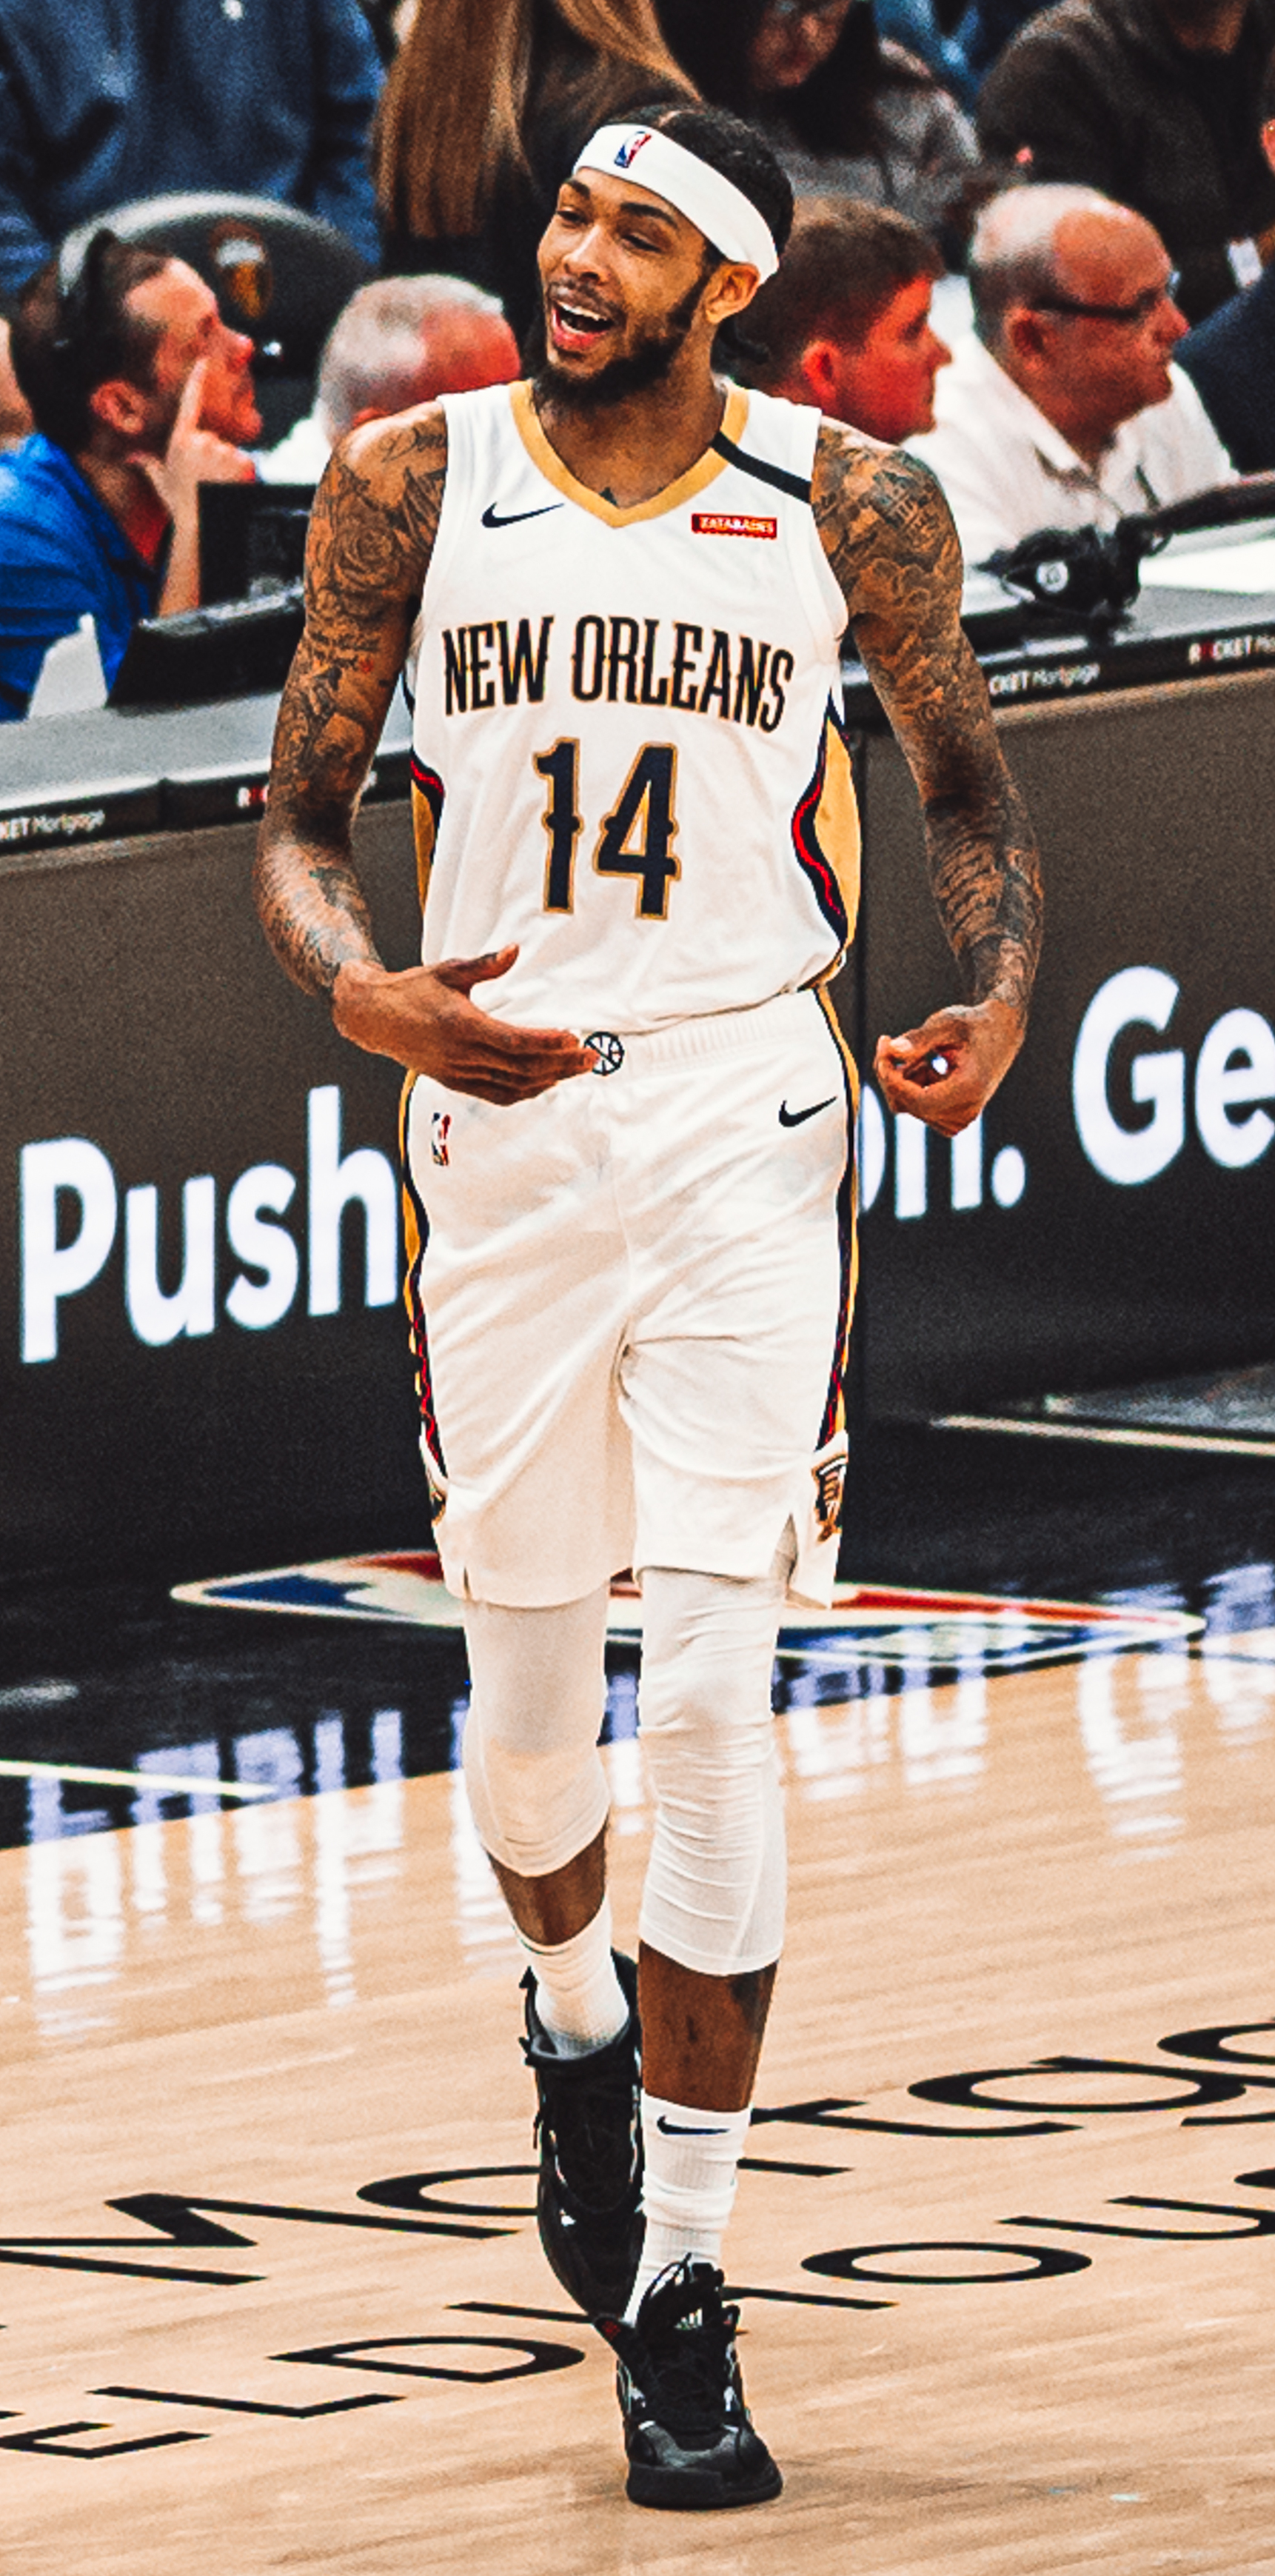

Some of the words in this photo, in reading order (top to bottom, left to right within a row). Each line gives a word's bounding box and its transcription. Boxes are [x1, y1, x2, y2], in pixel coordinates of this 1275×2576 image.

[442, 615, 555, 716] NEW
[572, 614, 795, 733] ORLEANS
[532, 736, 681, 921] 14
[20, 1084, 398, 1364] Push
